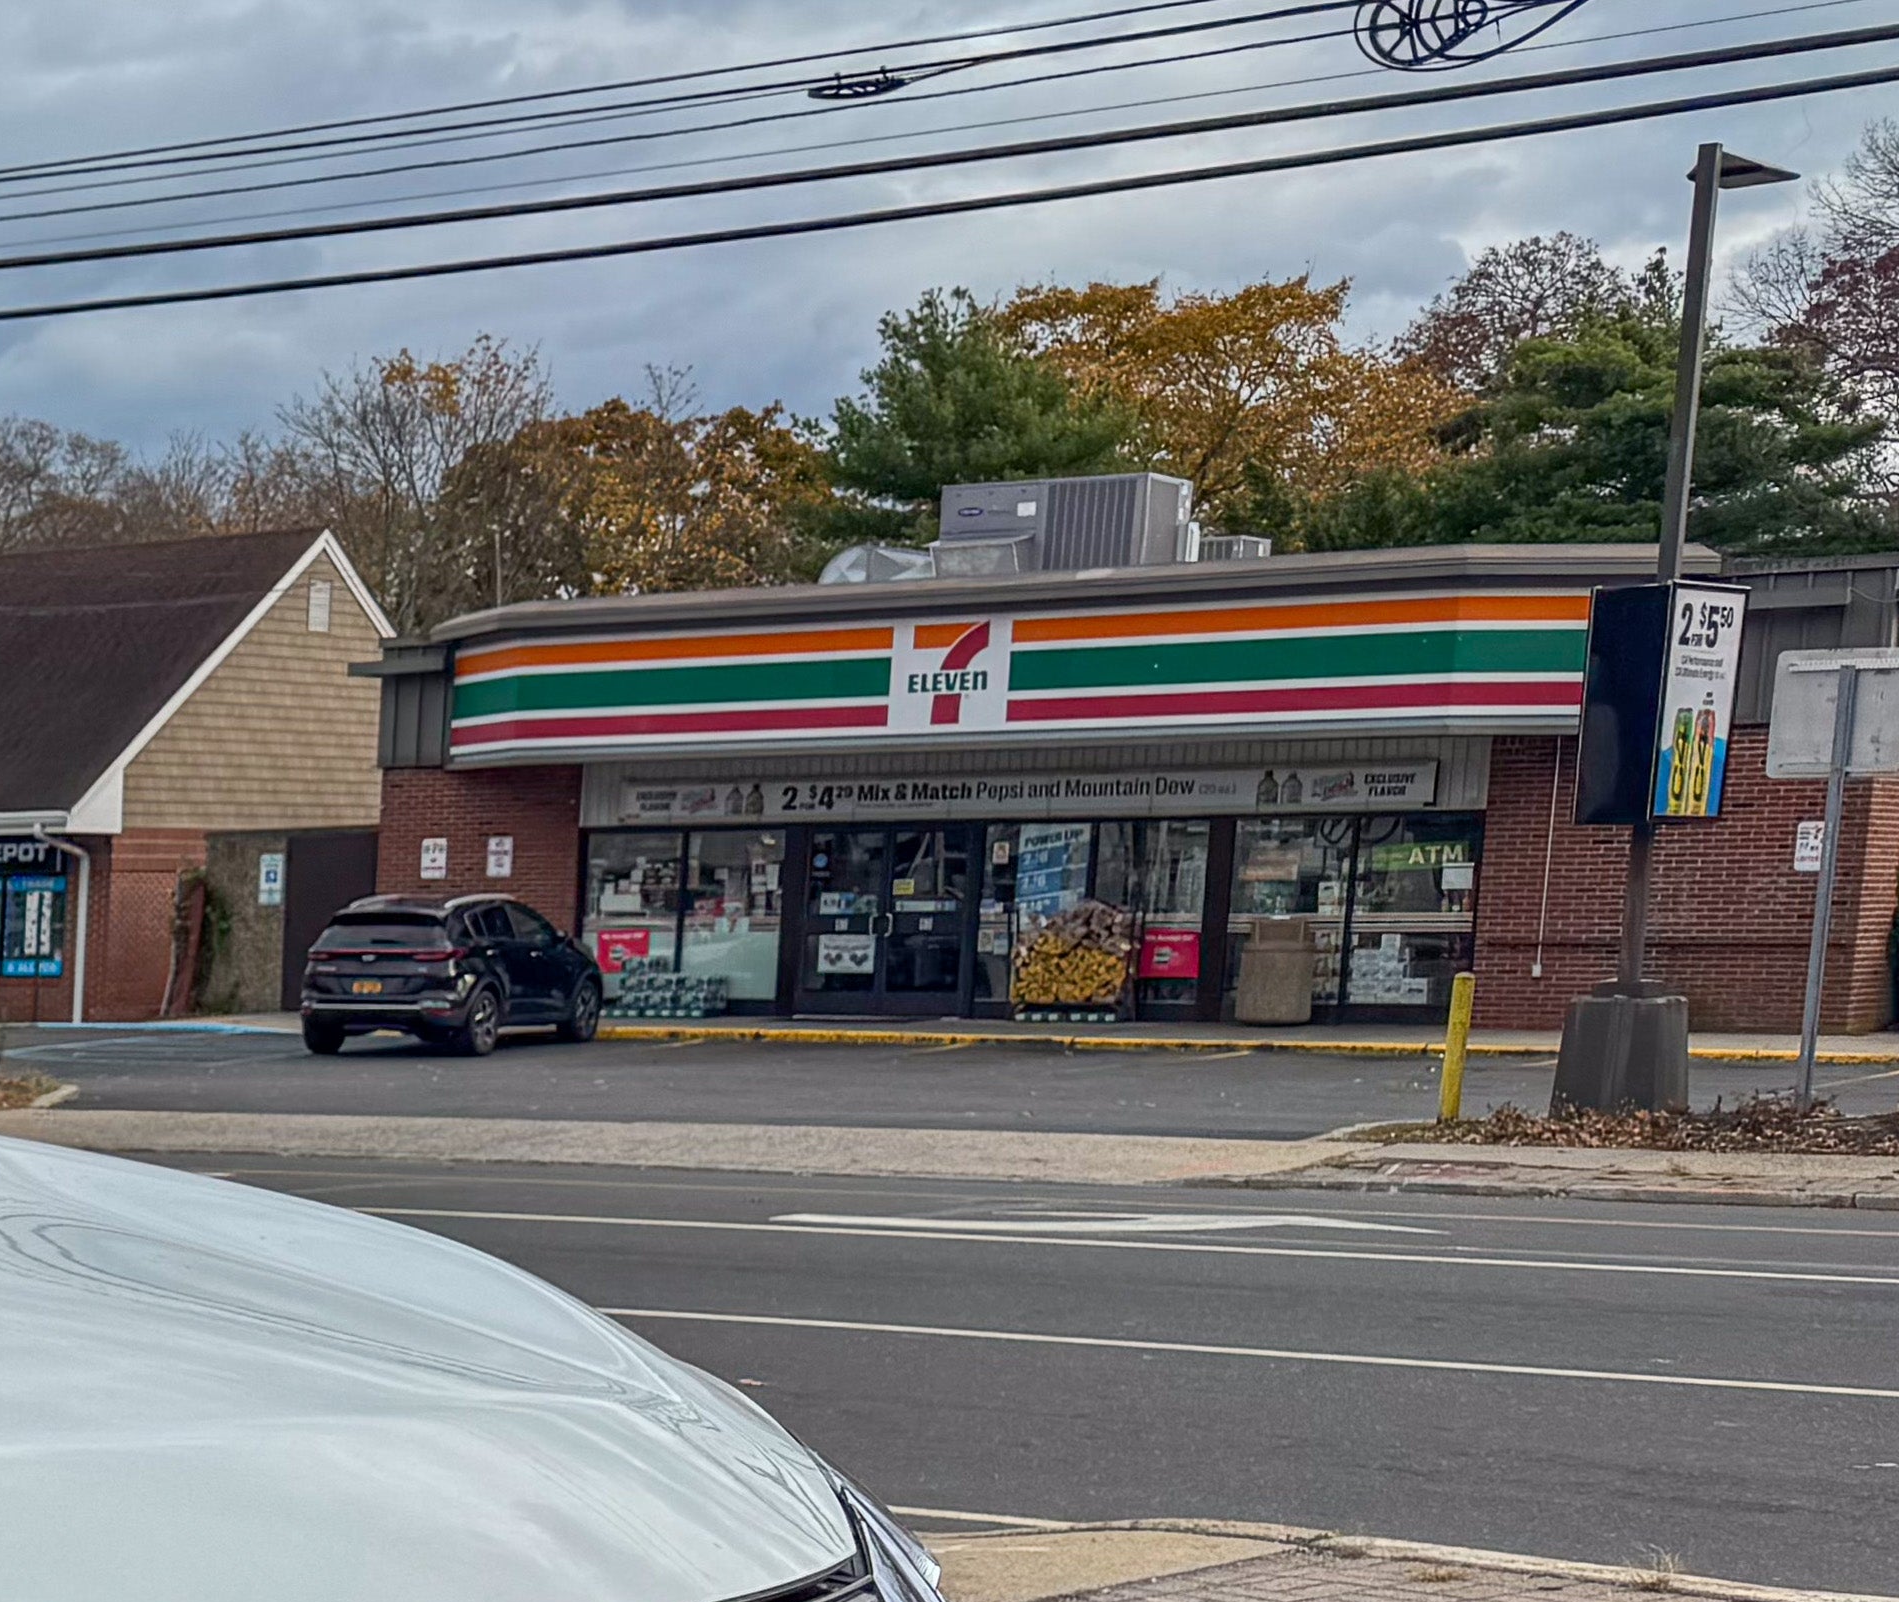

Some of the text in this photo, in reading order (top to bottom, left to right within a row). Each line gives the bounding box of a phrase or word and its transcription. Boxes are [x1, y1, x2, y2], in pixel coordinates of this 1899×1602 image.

[1678, 603, 1694, 646] 2
[913, 619, 990, 725] 7
[1364, 773, 1417, 785] EXCLUSIVE
[1368, 785, 1407, 797] FLAVOR
[782, 785, 798, 811] 2
[858, 784, 890, 801] Mix
[894, 782, 907, 801] &
[911, 779, 972, 800] Match
[976, 781, 1024, 803] Pepsi
[1028, 779, 1060, 798] and
[1065, 777, 1151, 797] Mountain
[1155, 776, 1195, 796] Dew
[1409, 844, 1464, 864] ATM
